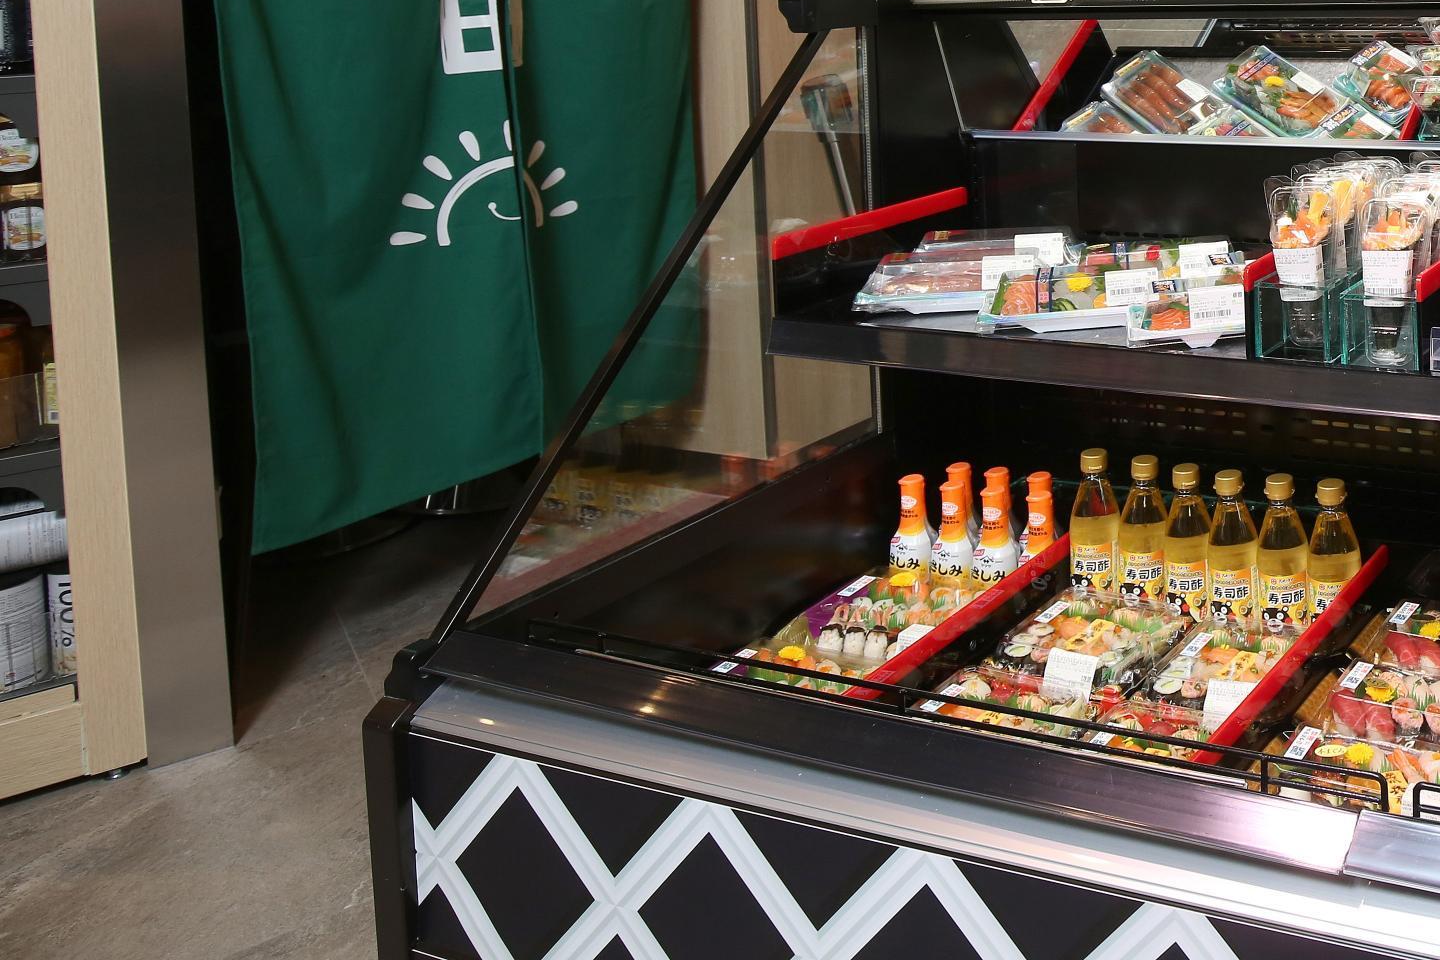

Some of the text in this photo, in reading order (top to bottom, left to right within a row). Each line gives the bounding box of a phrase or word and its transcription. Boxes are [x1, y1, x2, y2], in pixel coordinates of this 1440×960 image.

[1075, 559, 1110, 572] 寿司酢
[1126, 567, 1162, 580] 寿司酢
[1169, 578, 1203, 590] 寿司酢
[1214, 586, 1249, 599] 寿司酢
[1269, 589, 1305, 604] 寿司酢
